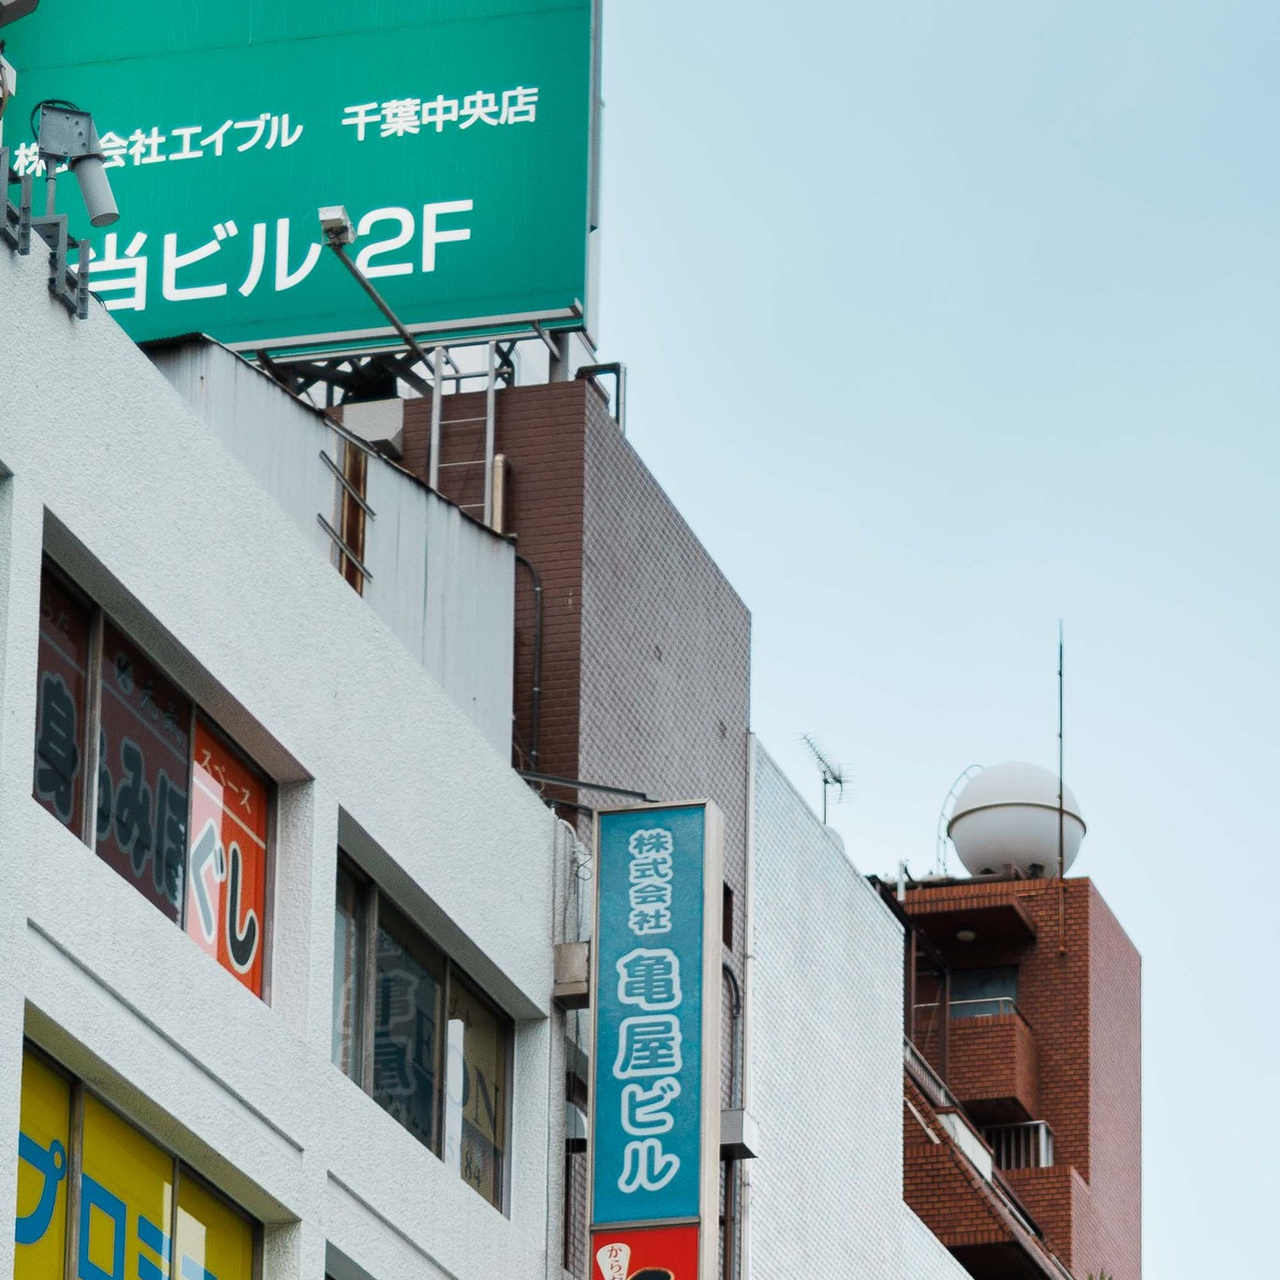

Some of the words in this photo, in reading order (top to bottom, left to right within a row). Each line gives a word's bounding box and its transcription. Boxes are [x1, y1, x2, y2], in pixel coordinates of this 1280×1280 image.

[13, 113, 304, 177] 株会社エイブル
[341, 86, 539, 141] 千葉中央店
[355, 200, 474, 280] 2F
[200, 748, 254, 815] スペース
[629, 828, 673, 936] 株式会社
[613, 947, 682, 1193] 亀屋ビル
